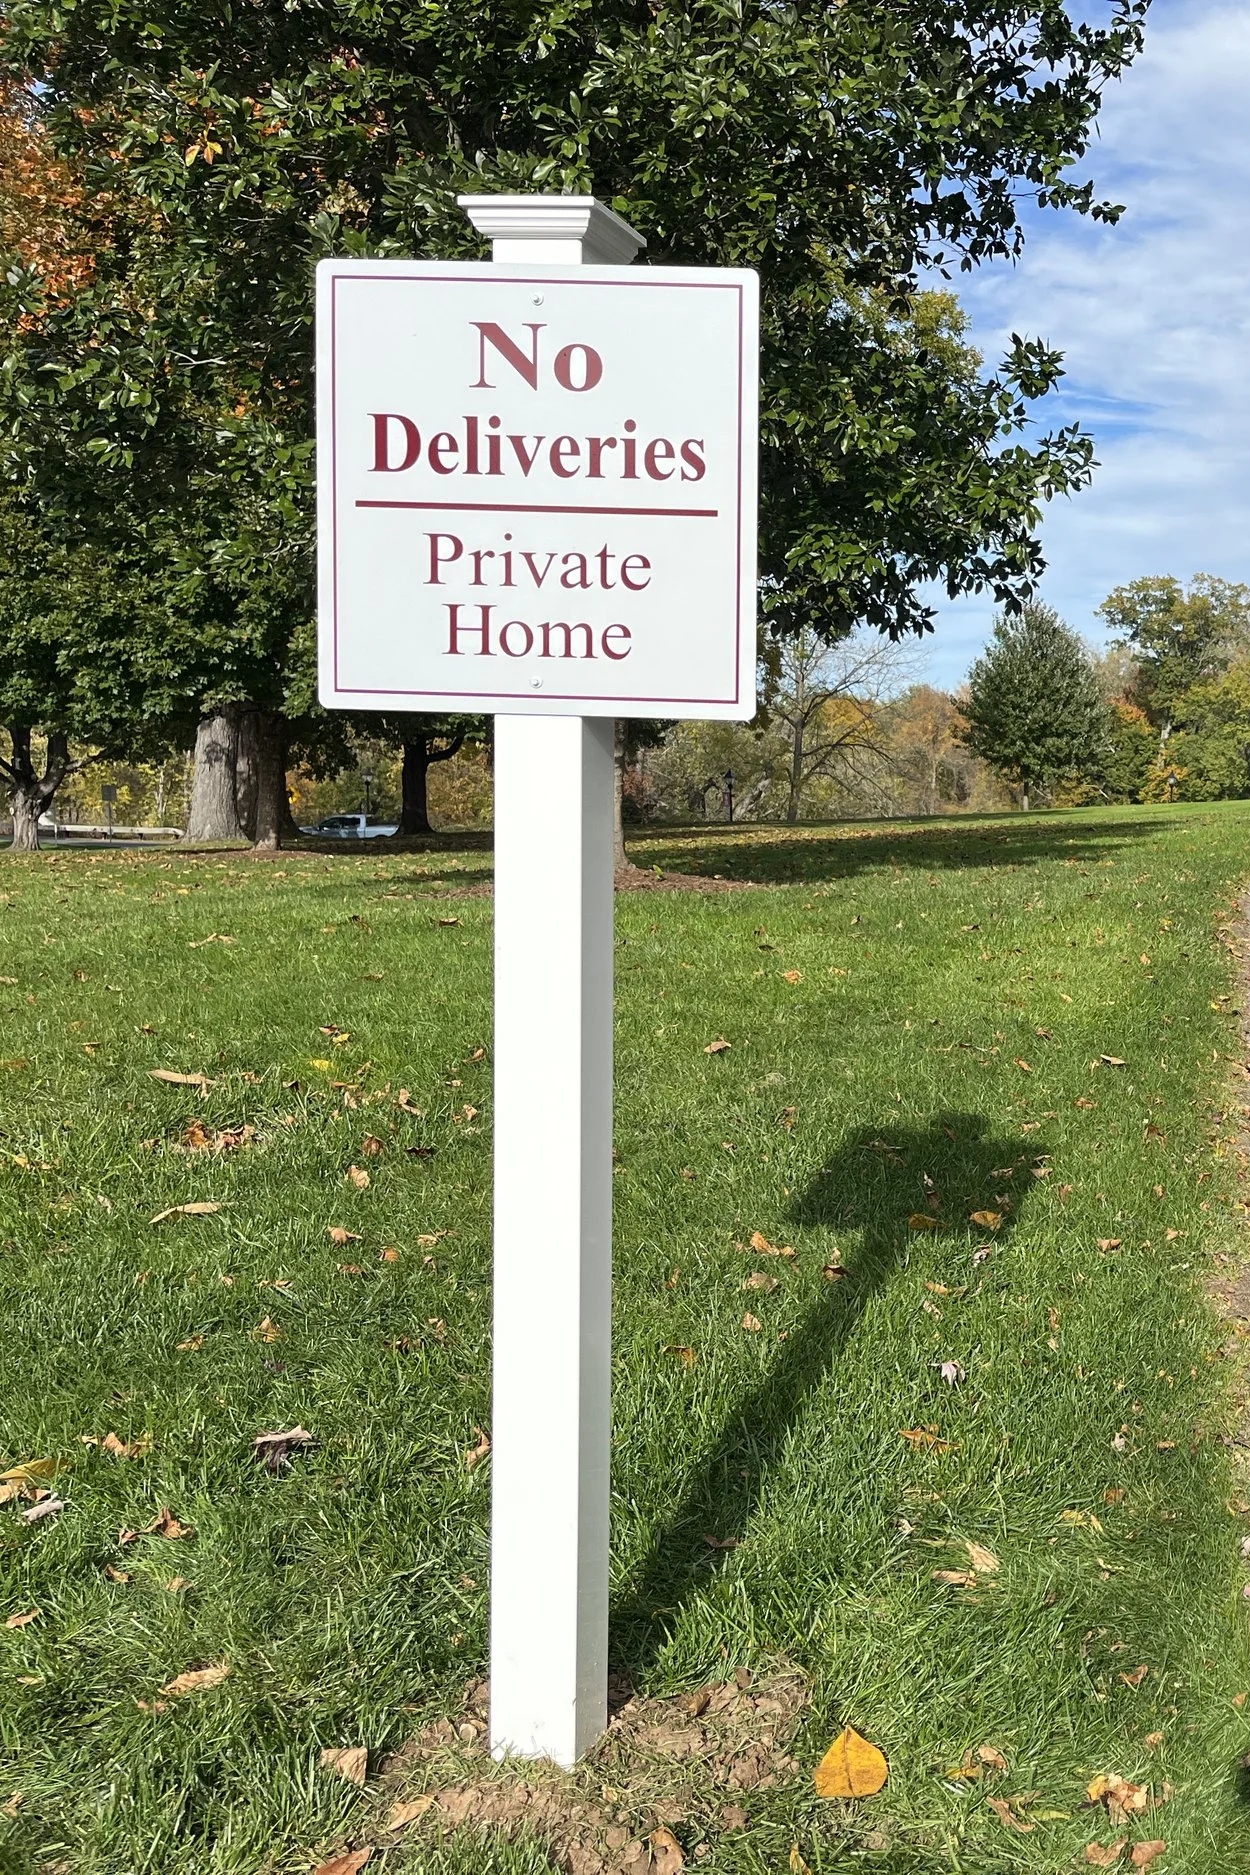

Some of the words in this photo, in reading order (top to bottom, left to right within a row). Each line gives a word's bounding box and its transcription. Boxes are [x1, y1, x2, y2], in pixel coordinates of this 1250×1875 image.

[469, 321, 604, 392] No
[366, 413, 707, 482] Deliveries
[423, 533, 652, 592] Private
[442, 603, 633, 661] Home
